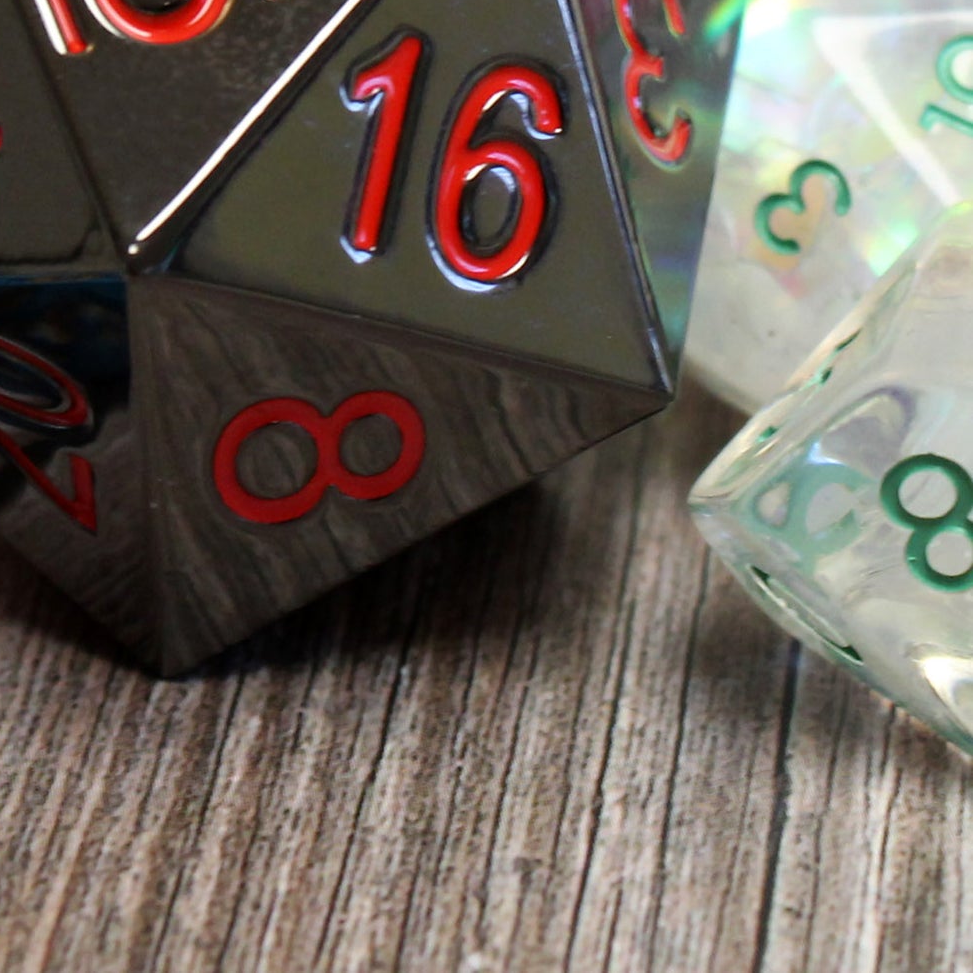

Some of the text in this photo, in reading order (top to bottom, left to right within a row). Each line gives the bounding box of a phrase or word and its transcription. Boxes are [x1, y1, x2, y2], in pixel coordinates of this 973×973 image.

[341, 31, 567, 291] 16
[753, 158, 852, 256] 3
[212, 389, 426, 524] 8
[880, 453, 973, 593] 8
